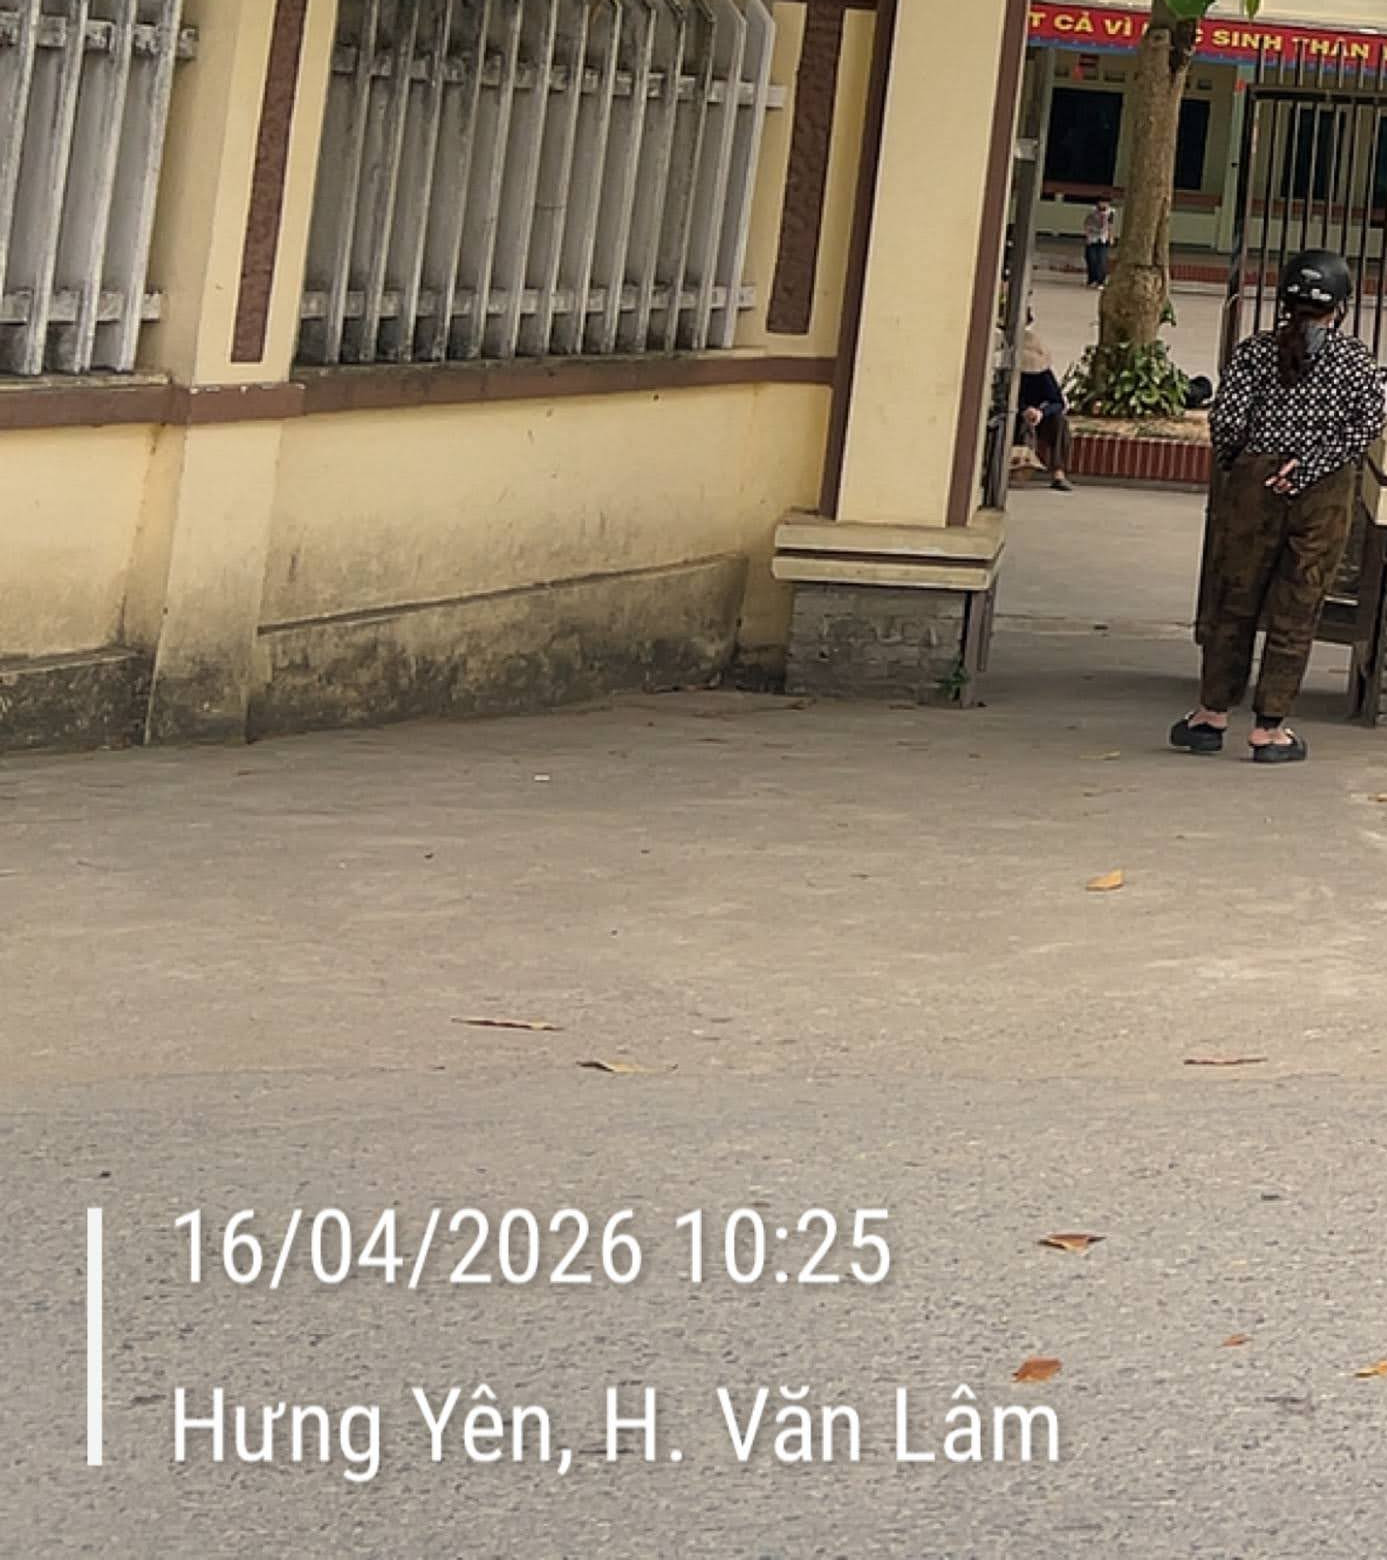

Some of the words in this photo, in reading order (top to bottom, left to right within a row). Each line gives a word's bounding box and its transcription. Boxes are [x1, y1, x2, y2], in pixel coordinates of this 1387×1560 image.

[1053, 11, 1095, 33] CẢ
[1104, 16, 1132, 37] VÌ
[1212, 28, 1284, 52] SINH
[1292, 37, 1370, 60] THÂN
